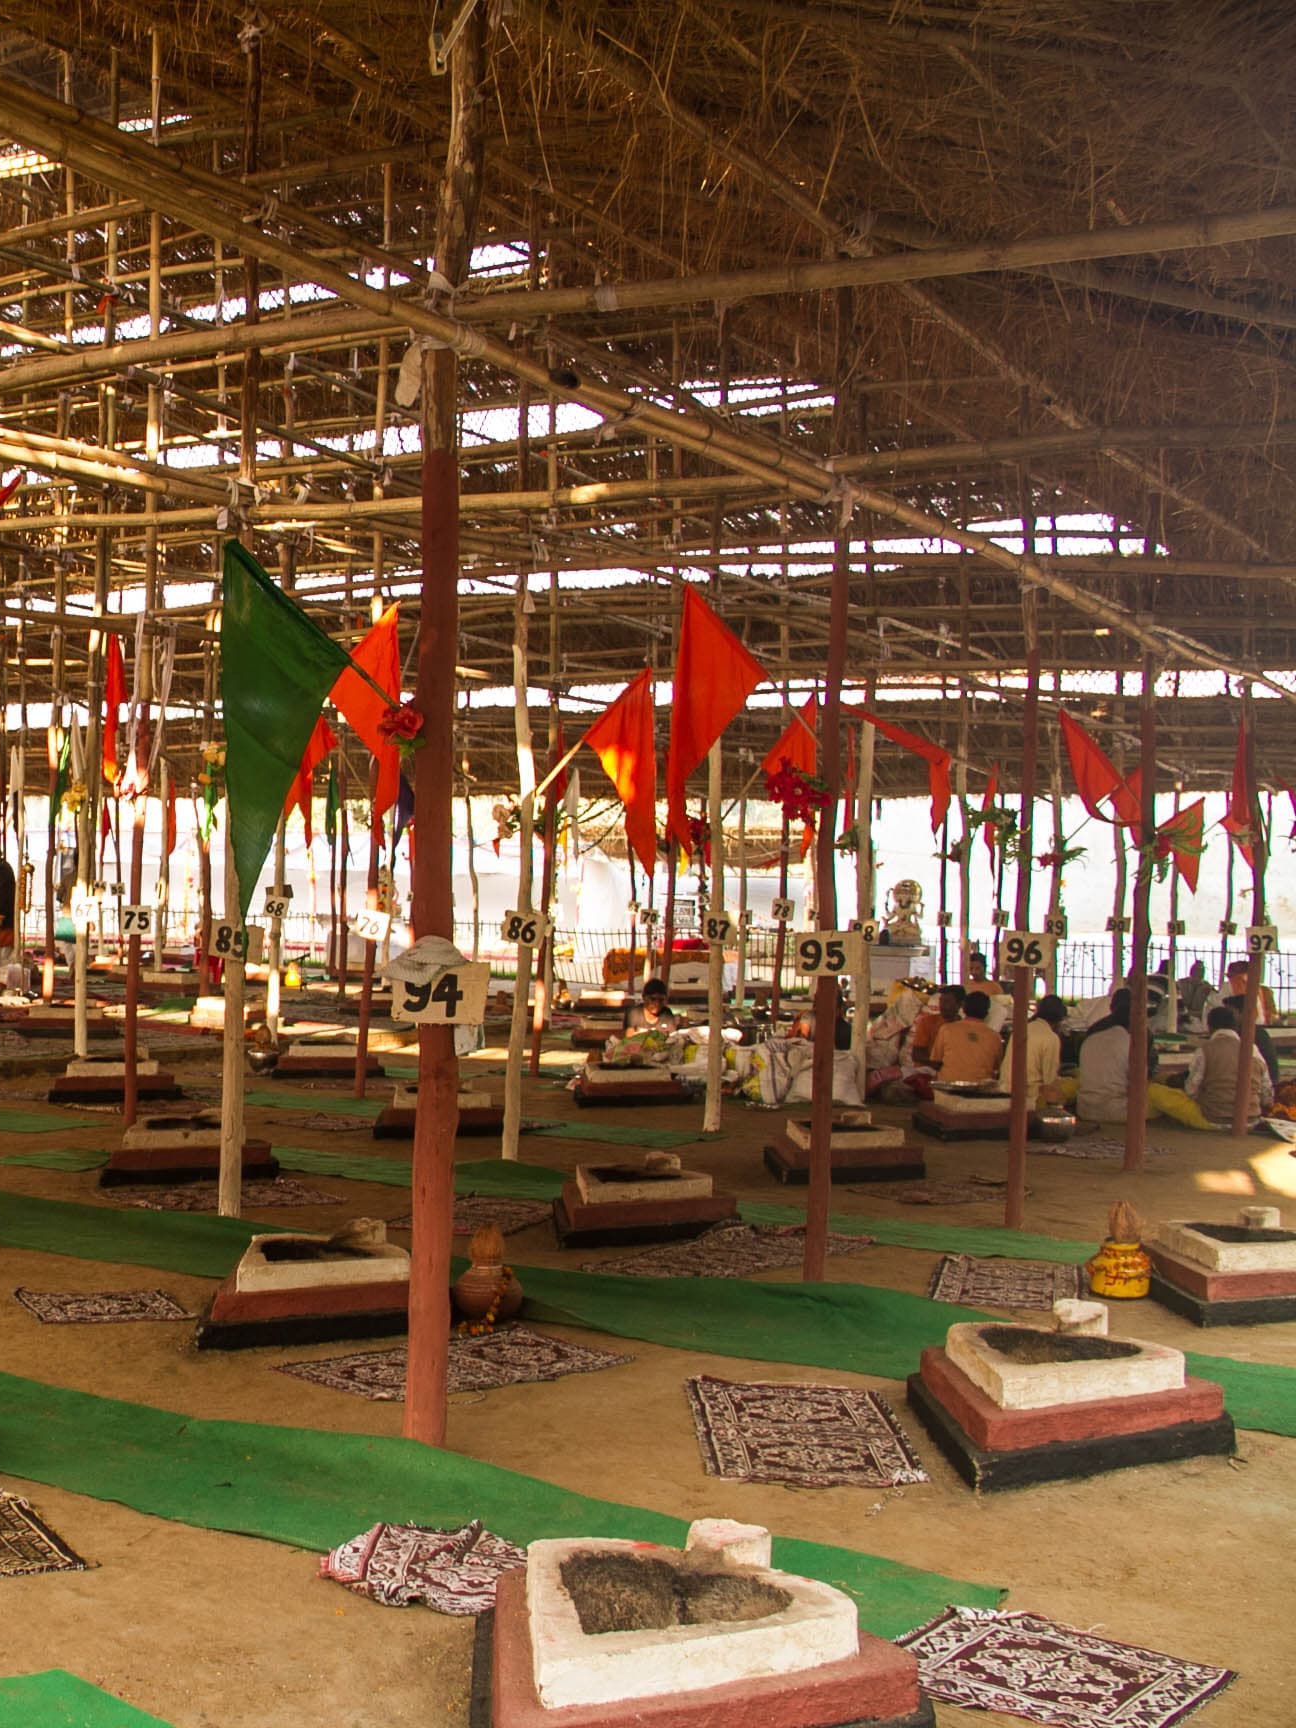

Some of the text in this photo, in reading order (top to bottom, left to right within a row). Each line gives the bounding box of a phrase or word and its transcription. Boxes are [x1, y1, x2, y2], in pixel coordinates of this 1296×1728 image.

[75, 904, 93, 917] 67
[265, 900, 285, 916] 68
[774, 904, 790, 918] 78
[124, 911, 149, 930] 75
[359, 916, 379, 935] 76
[507, 916, 537, 943] 86
[707, 918, 730, 940] 87
[1047, 919, 1064, 936] 89
[1006, 938, 1042, 965] 96
[1249, 935, 1273, 951] 97
[800, 940, 846, 971] 95
[403, 973, 464, 1018] 94
